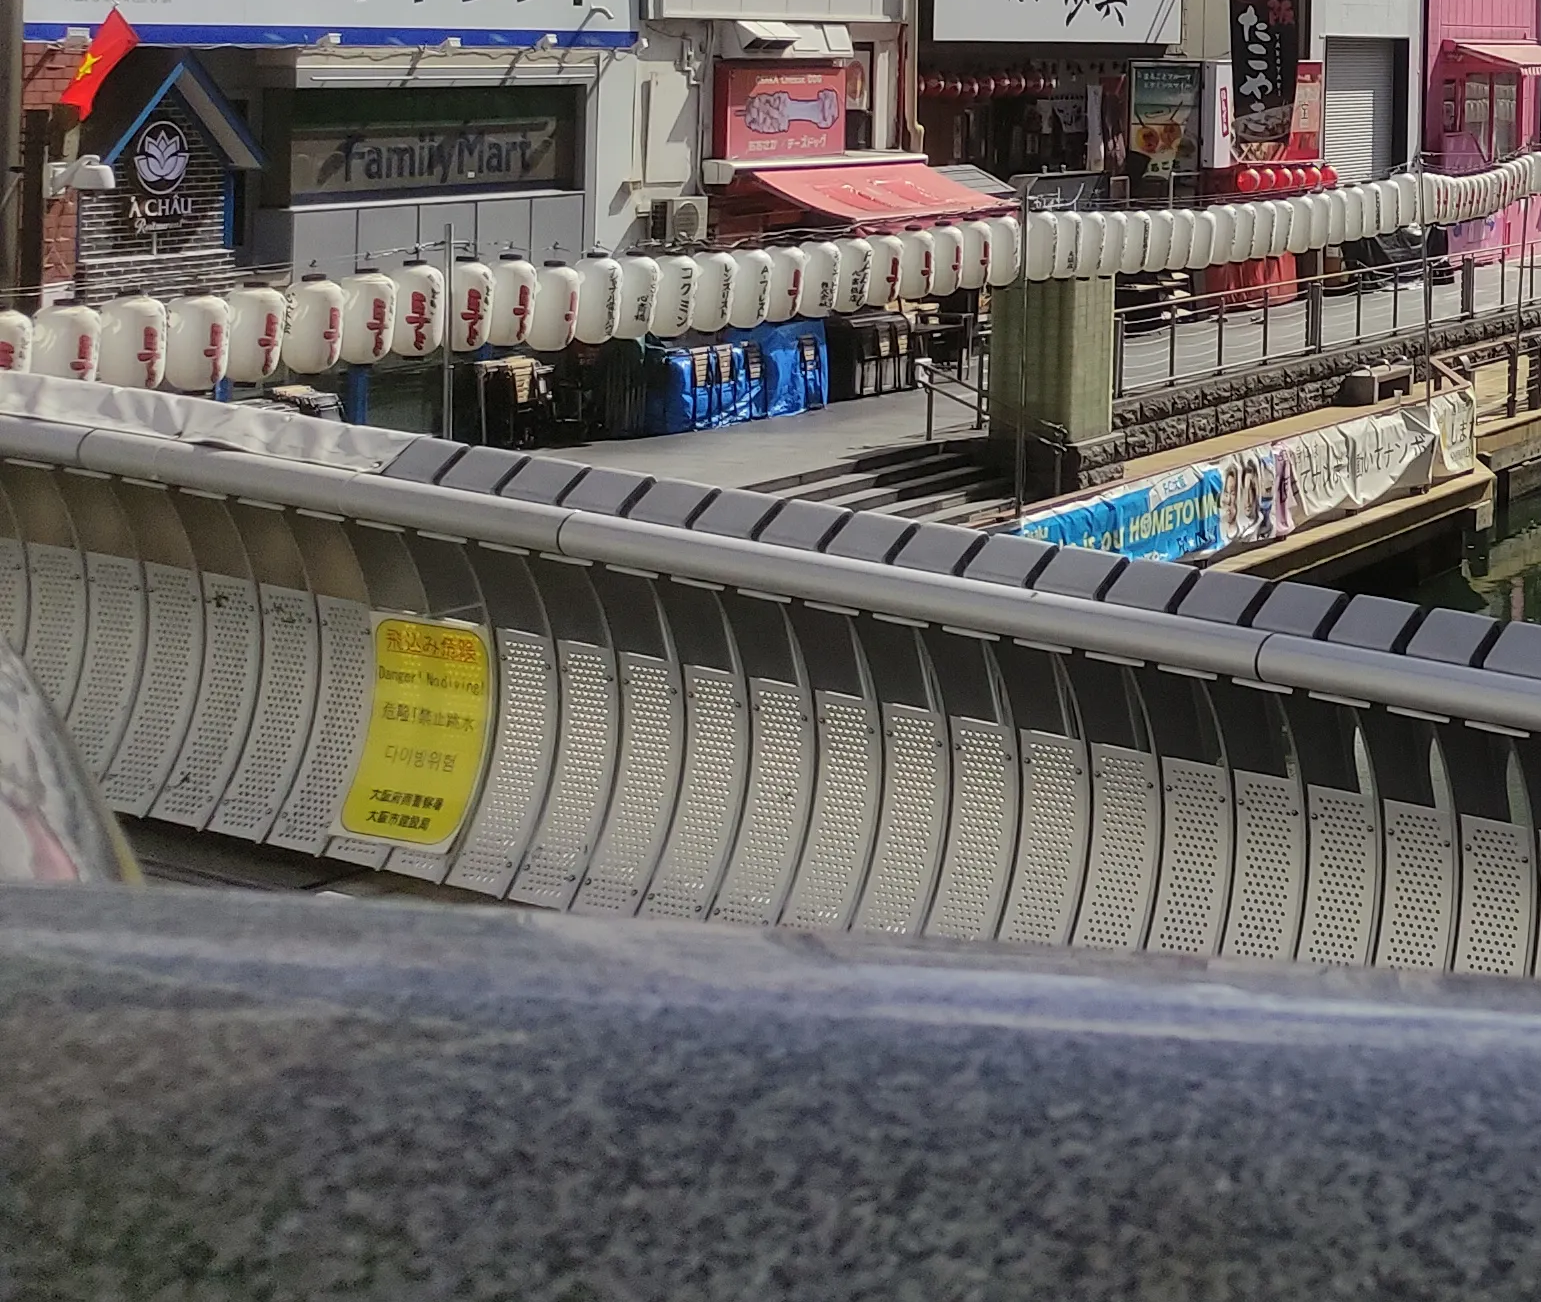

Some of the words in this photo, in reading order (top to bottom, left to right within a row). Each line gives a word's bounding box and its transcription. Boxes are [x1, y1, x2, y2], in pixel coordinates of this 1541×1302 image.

[1237, 4, 1274, 134] たこやき
[676, 266, 694, 328] コクミン
